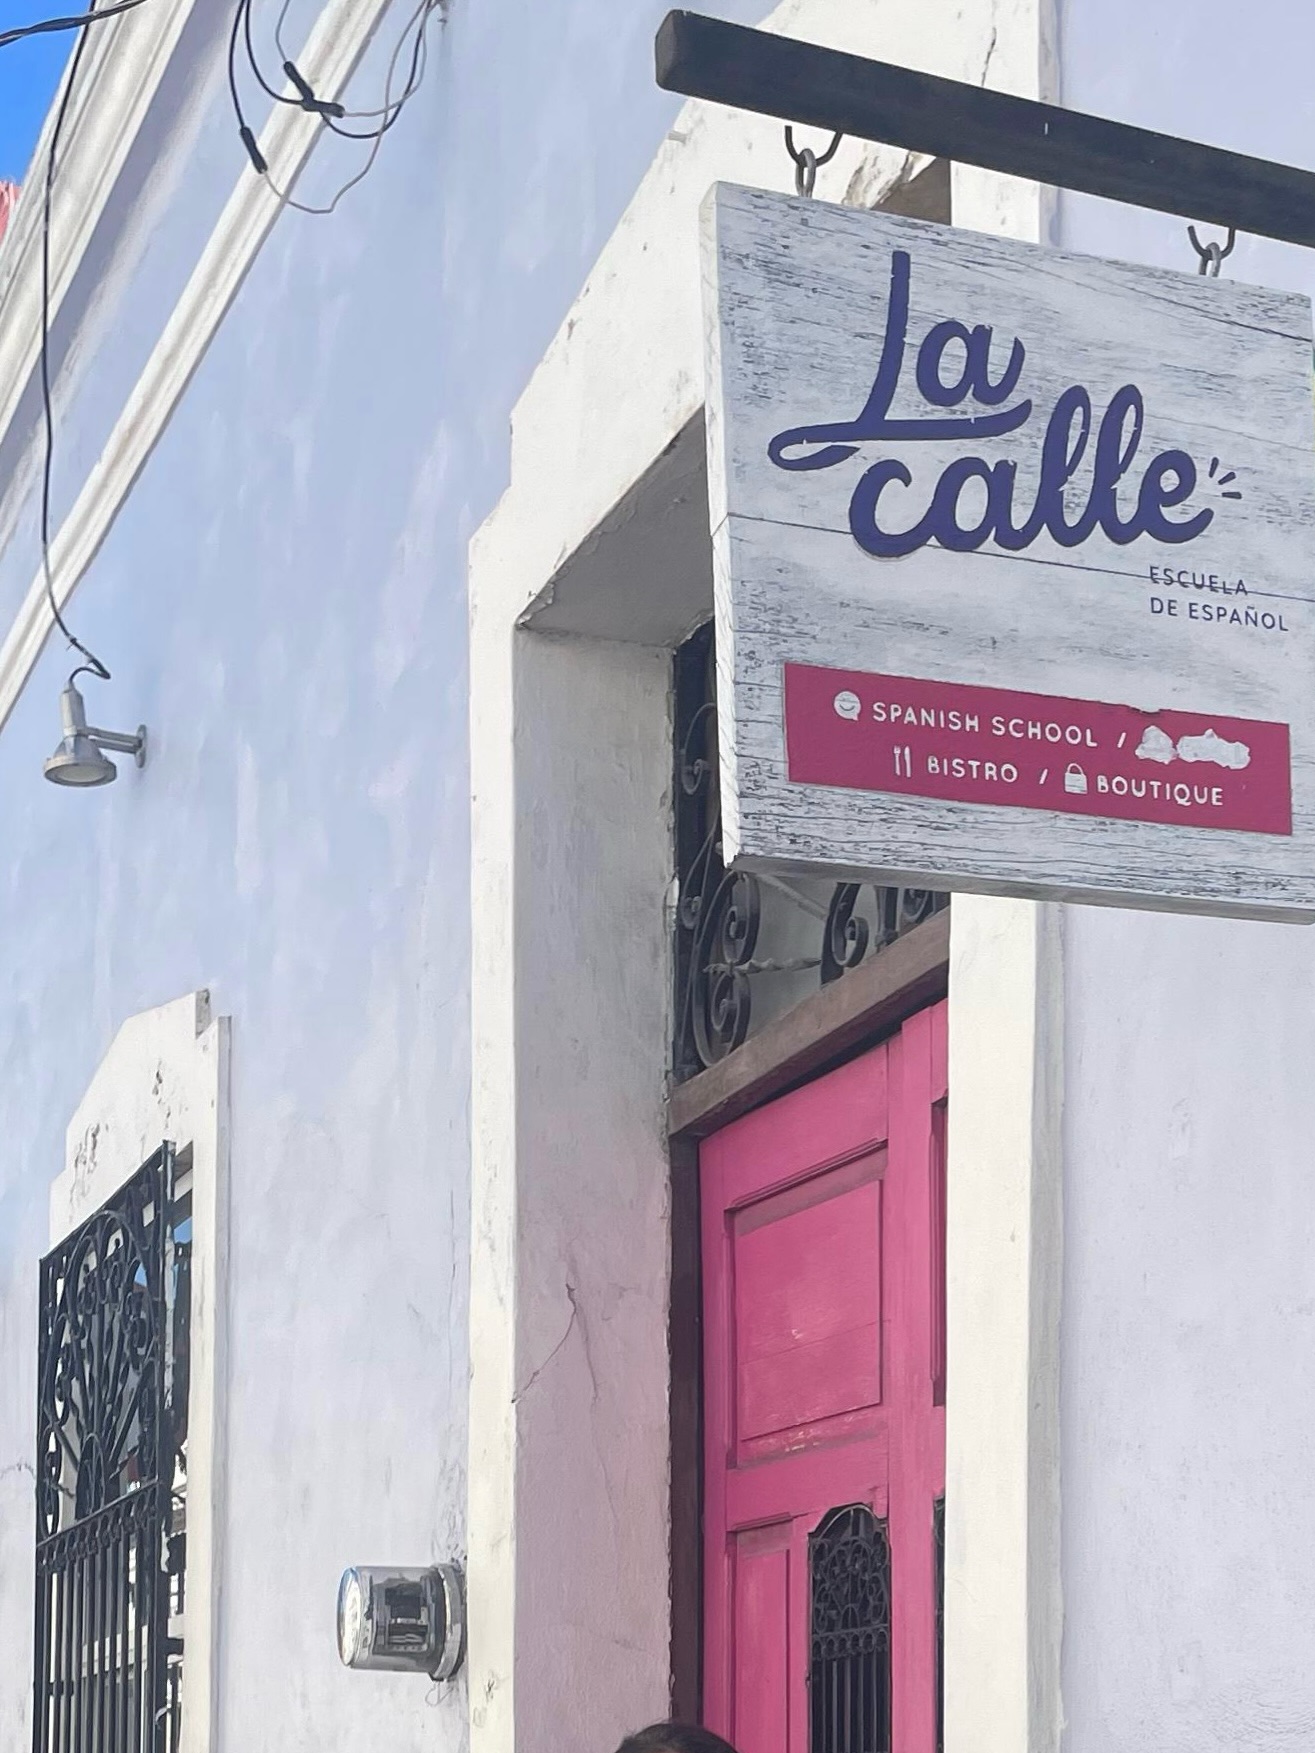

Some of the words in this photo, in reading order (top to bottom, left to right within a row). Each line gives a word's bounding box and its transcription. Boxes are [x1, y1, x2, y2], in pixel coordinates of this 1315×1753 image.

[767, 251, 1032, 471] La
[848, 384, 1214, 557] calle
[1149, 565, 1248, 596] ESCUELA
[1150, 597, 1178, 617] DE
[1188, 602, 1289, 632] ESPAÑOL
[872, 701, 979, 733] SPANISH
[991, 716, 1098, 747] SCHOOL
[927, 755, 1018, 783] BISTRO
[1096, 775, 1224, 807] BOUTIQUE
